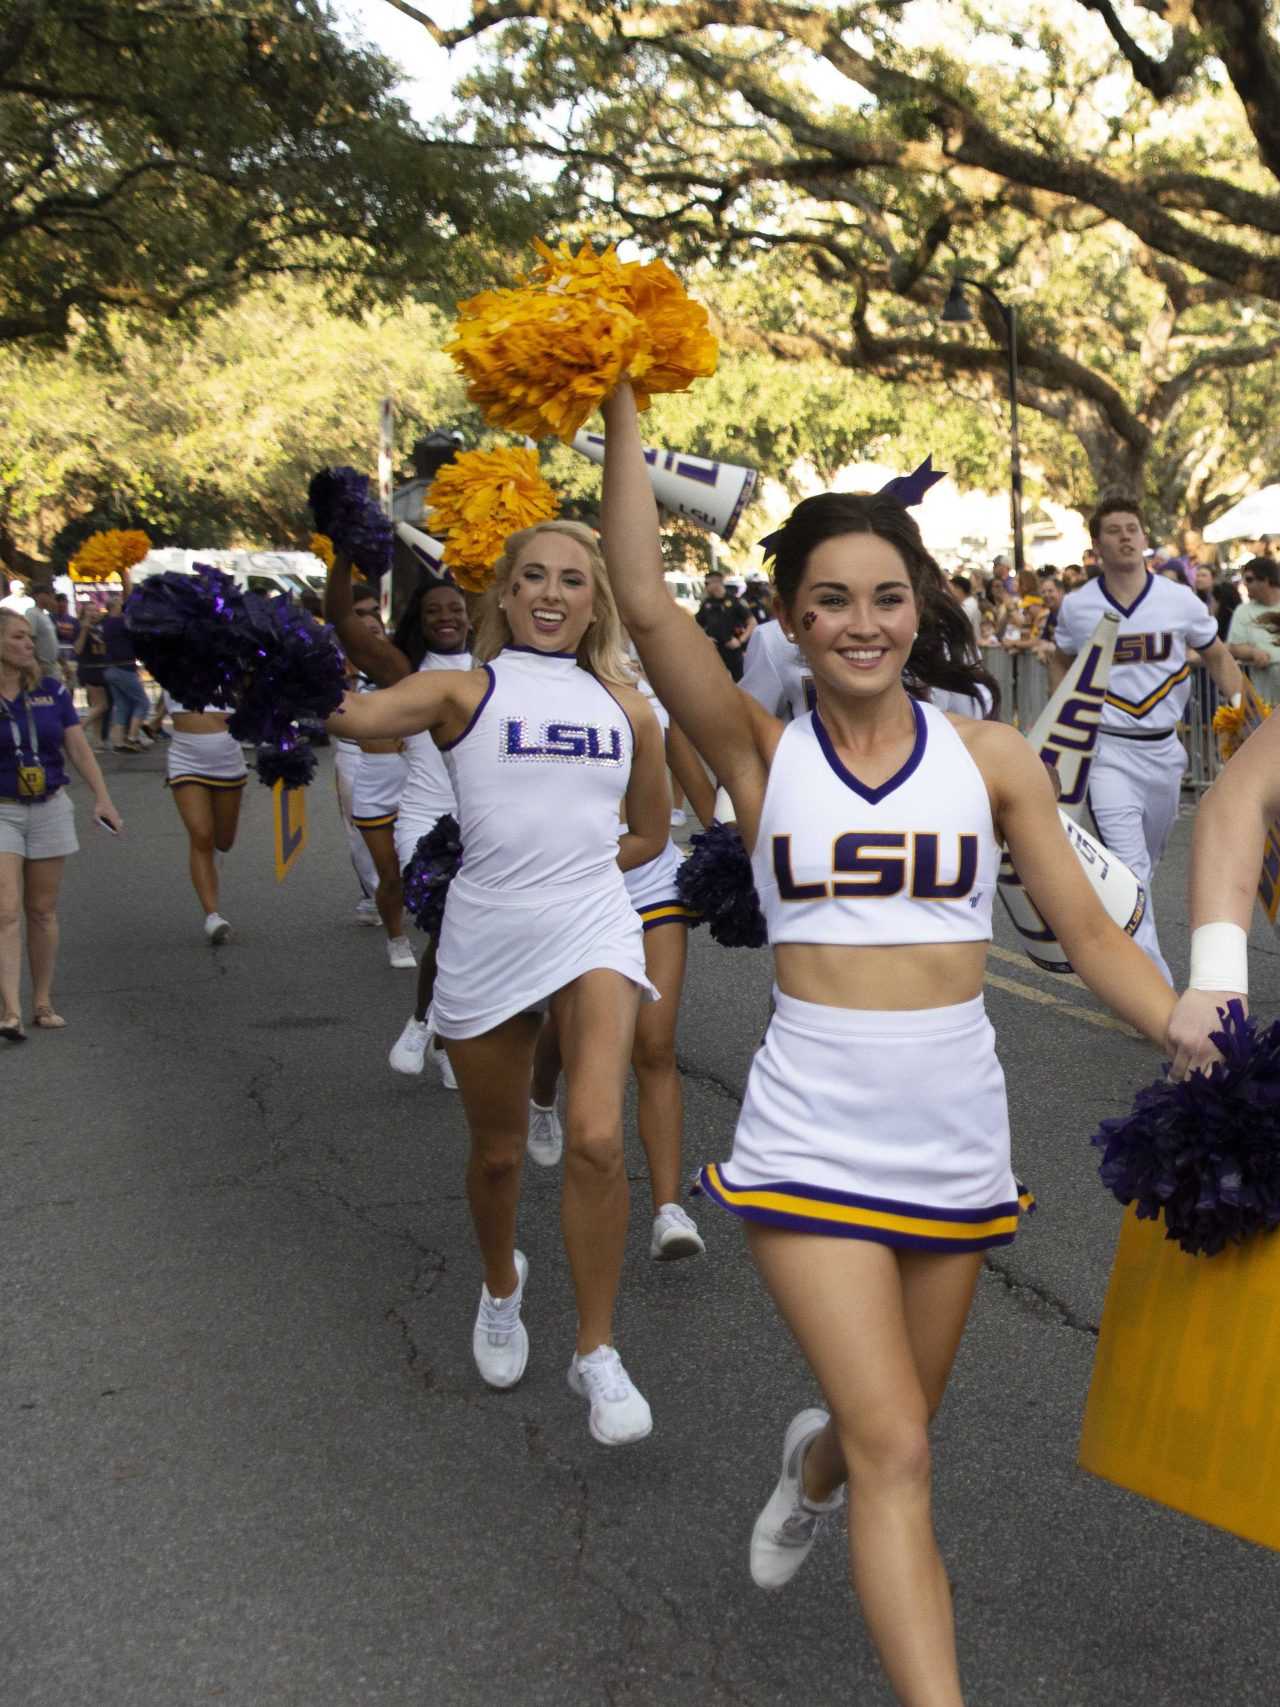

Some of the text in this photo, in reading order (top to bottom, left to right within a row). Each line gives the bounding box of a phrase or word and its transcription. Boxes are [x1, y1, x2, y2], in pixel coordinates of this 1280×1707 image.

[678, 503, 716, 527] LSU
[1112, 632, 1173, 665] SU
[499, 717, 624, 768] LSU
[771, 830, 979, 902] LSU
